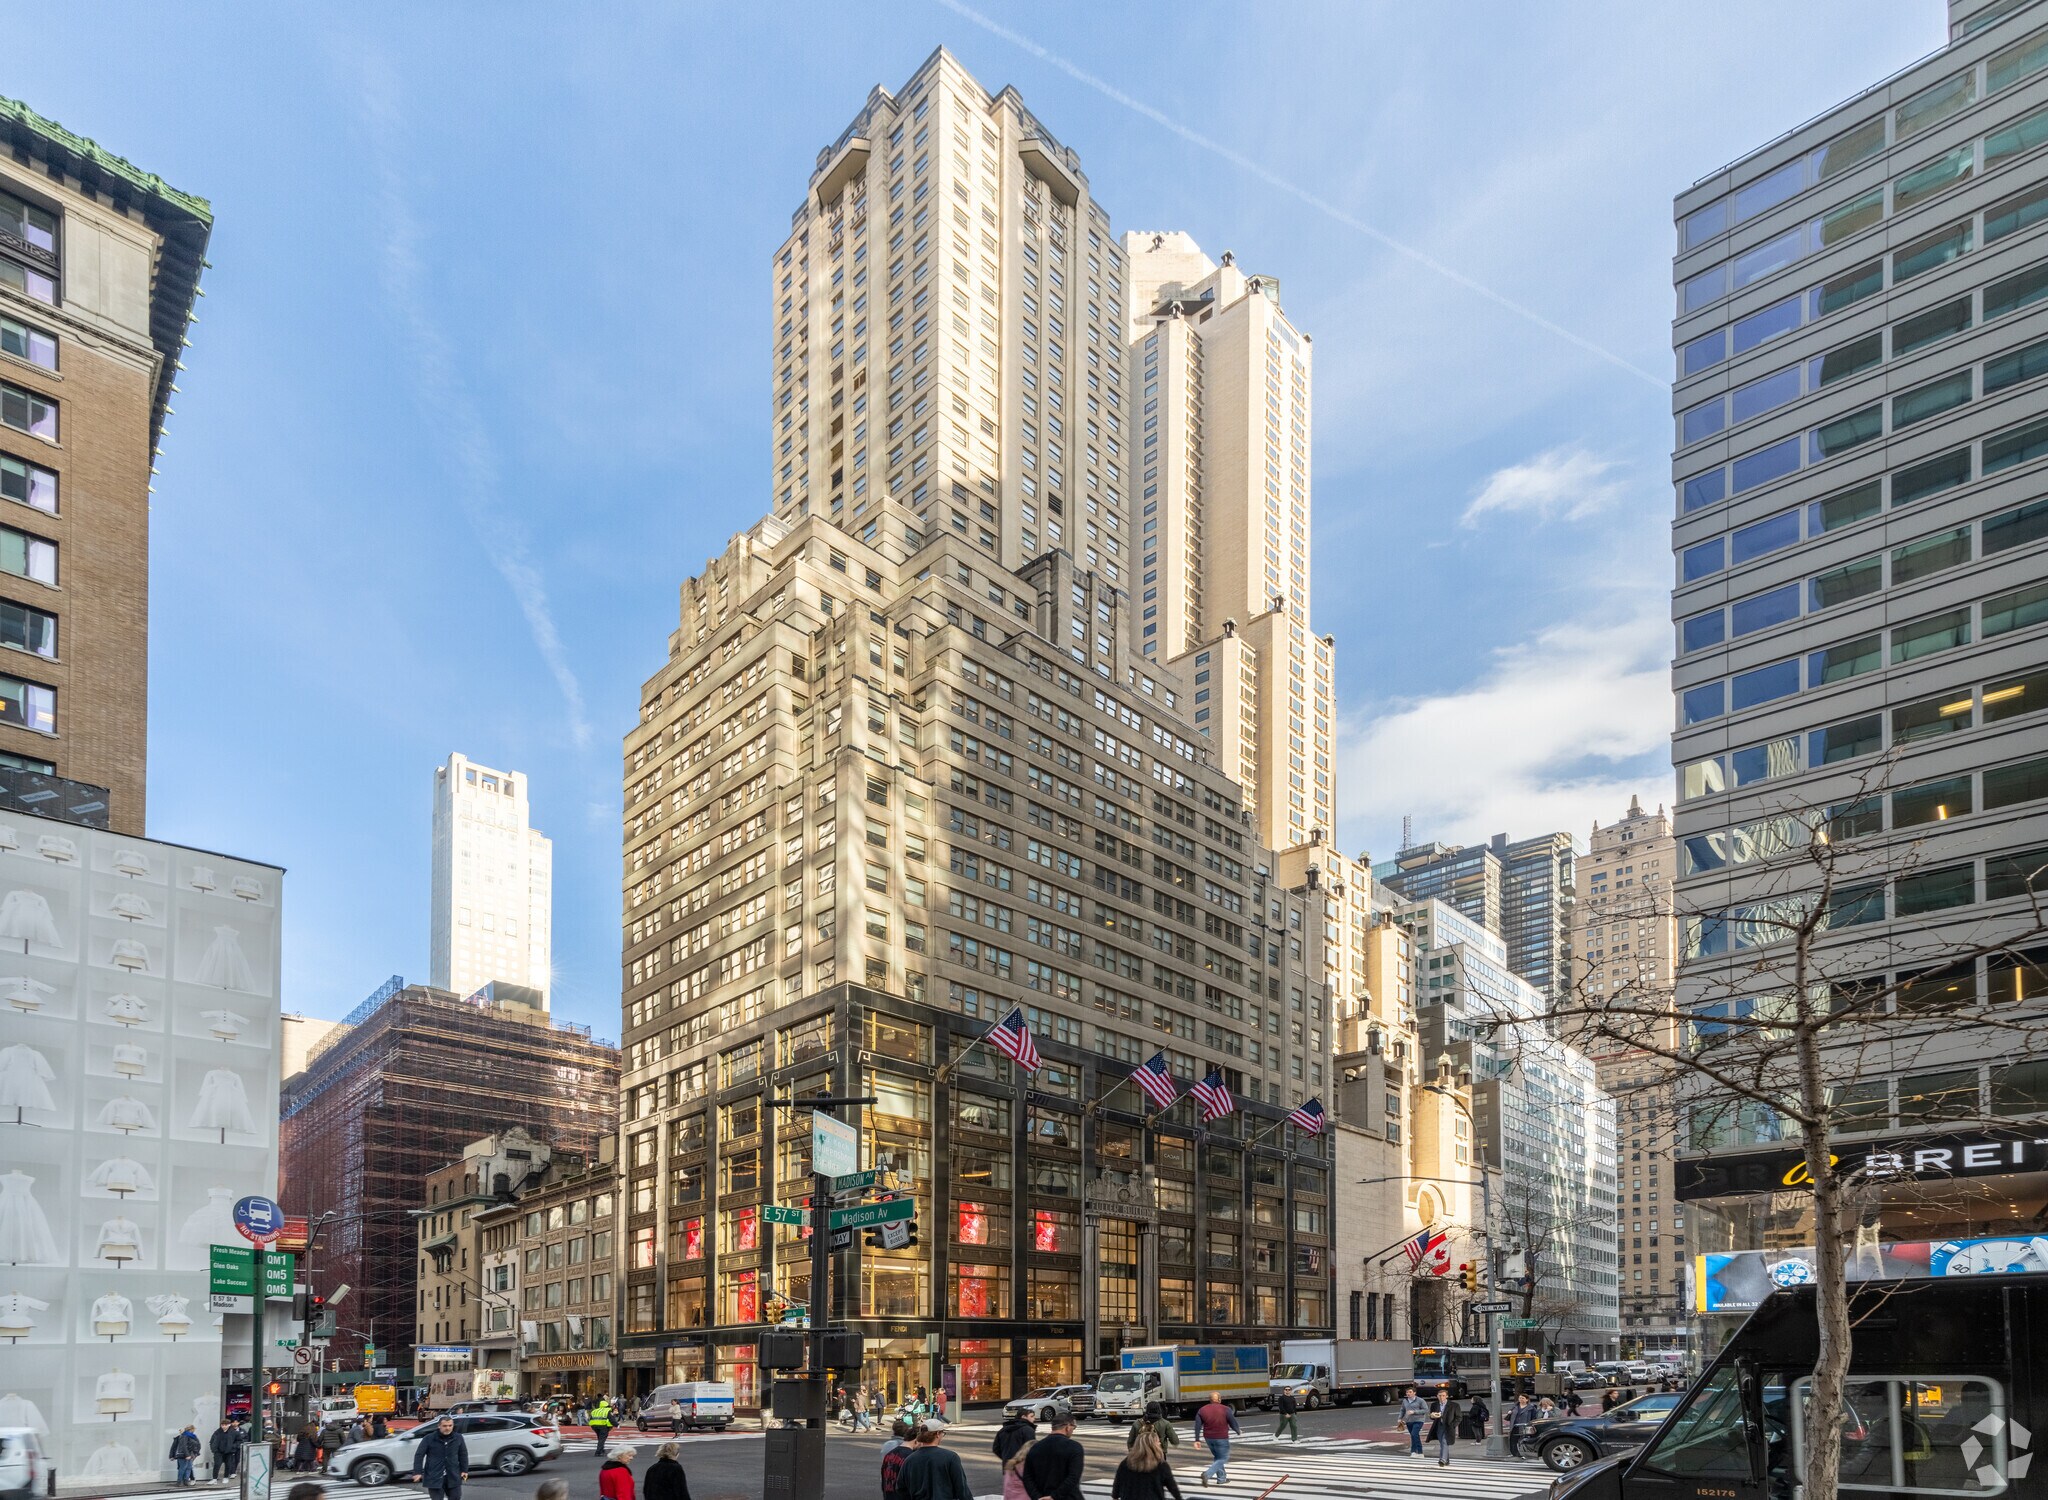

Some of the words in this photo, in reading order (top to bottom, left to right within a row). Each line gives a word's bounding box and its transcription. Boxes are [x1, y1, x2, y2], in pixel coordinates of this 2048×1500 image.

[837, 1174, 864, 1190] MADISON
[865, 1171, 874, 1180] AV
[1091, 1201, 1119, 1213] FULLER
[764, 1207, 771, 1220] E
[775, 1208, 788, 1222] 57
[841, 1210, 875, 1226] Madison
[877, 1208, 888, 1219] Av
[239, 1225, 250, 1236] NO
[249, 1230, 280, 1243] STANDING
[887, 1228, 904, 1240] EXCEPT
[889, 1236, 904, 1245] BUSES
[213, 1246, 228, 1254] Fresh
[229, 1248, 250, 1256] Meadow
[267, 1255, 287, 1266] QM1
[266, 1269, 287, 1280] QM5
[266, 1284, 287, 1295] QM6
[890, 1325, 908, 1333] FENDI
[1696, 1488, 1736, 1498] 152176
